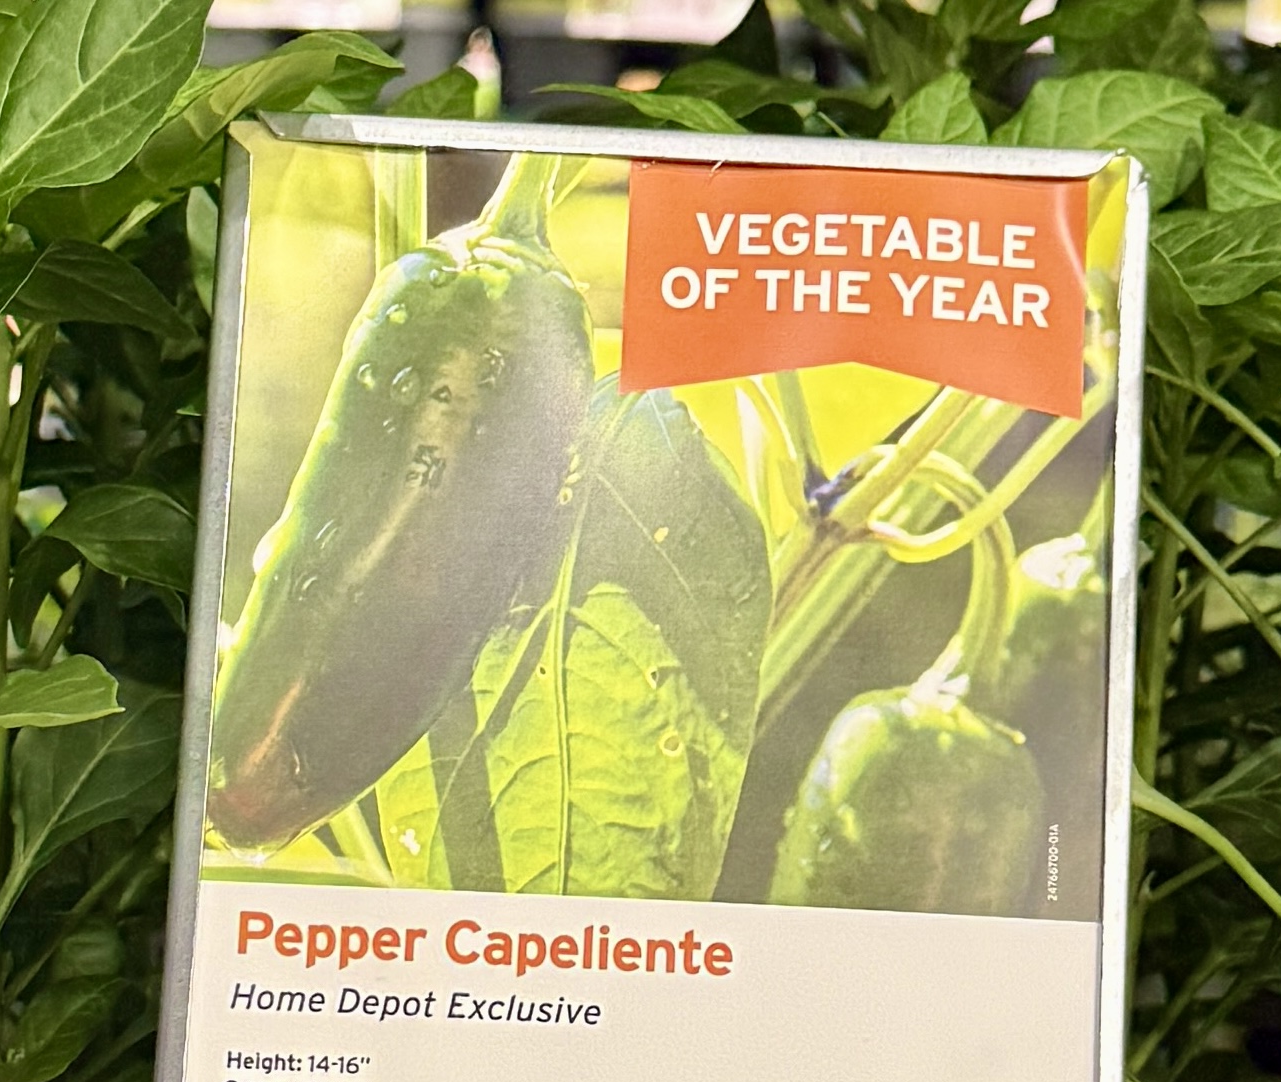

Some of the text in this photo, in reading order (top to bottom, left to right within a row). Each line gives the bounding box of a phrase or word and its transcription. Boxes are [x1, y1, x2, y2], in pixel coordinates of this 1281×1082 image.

[694, 211, 1037, 269] VEGETABLE
[660, 266, 1051, 329] OF THE YEAR
[236, 910, 734, 978] Pepper Capeliente
[230, 982, 602, 1026] Home Depot Exclusive
[226, 1050, 302, 1075] Height:
